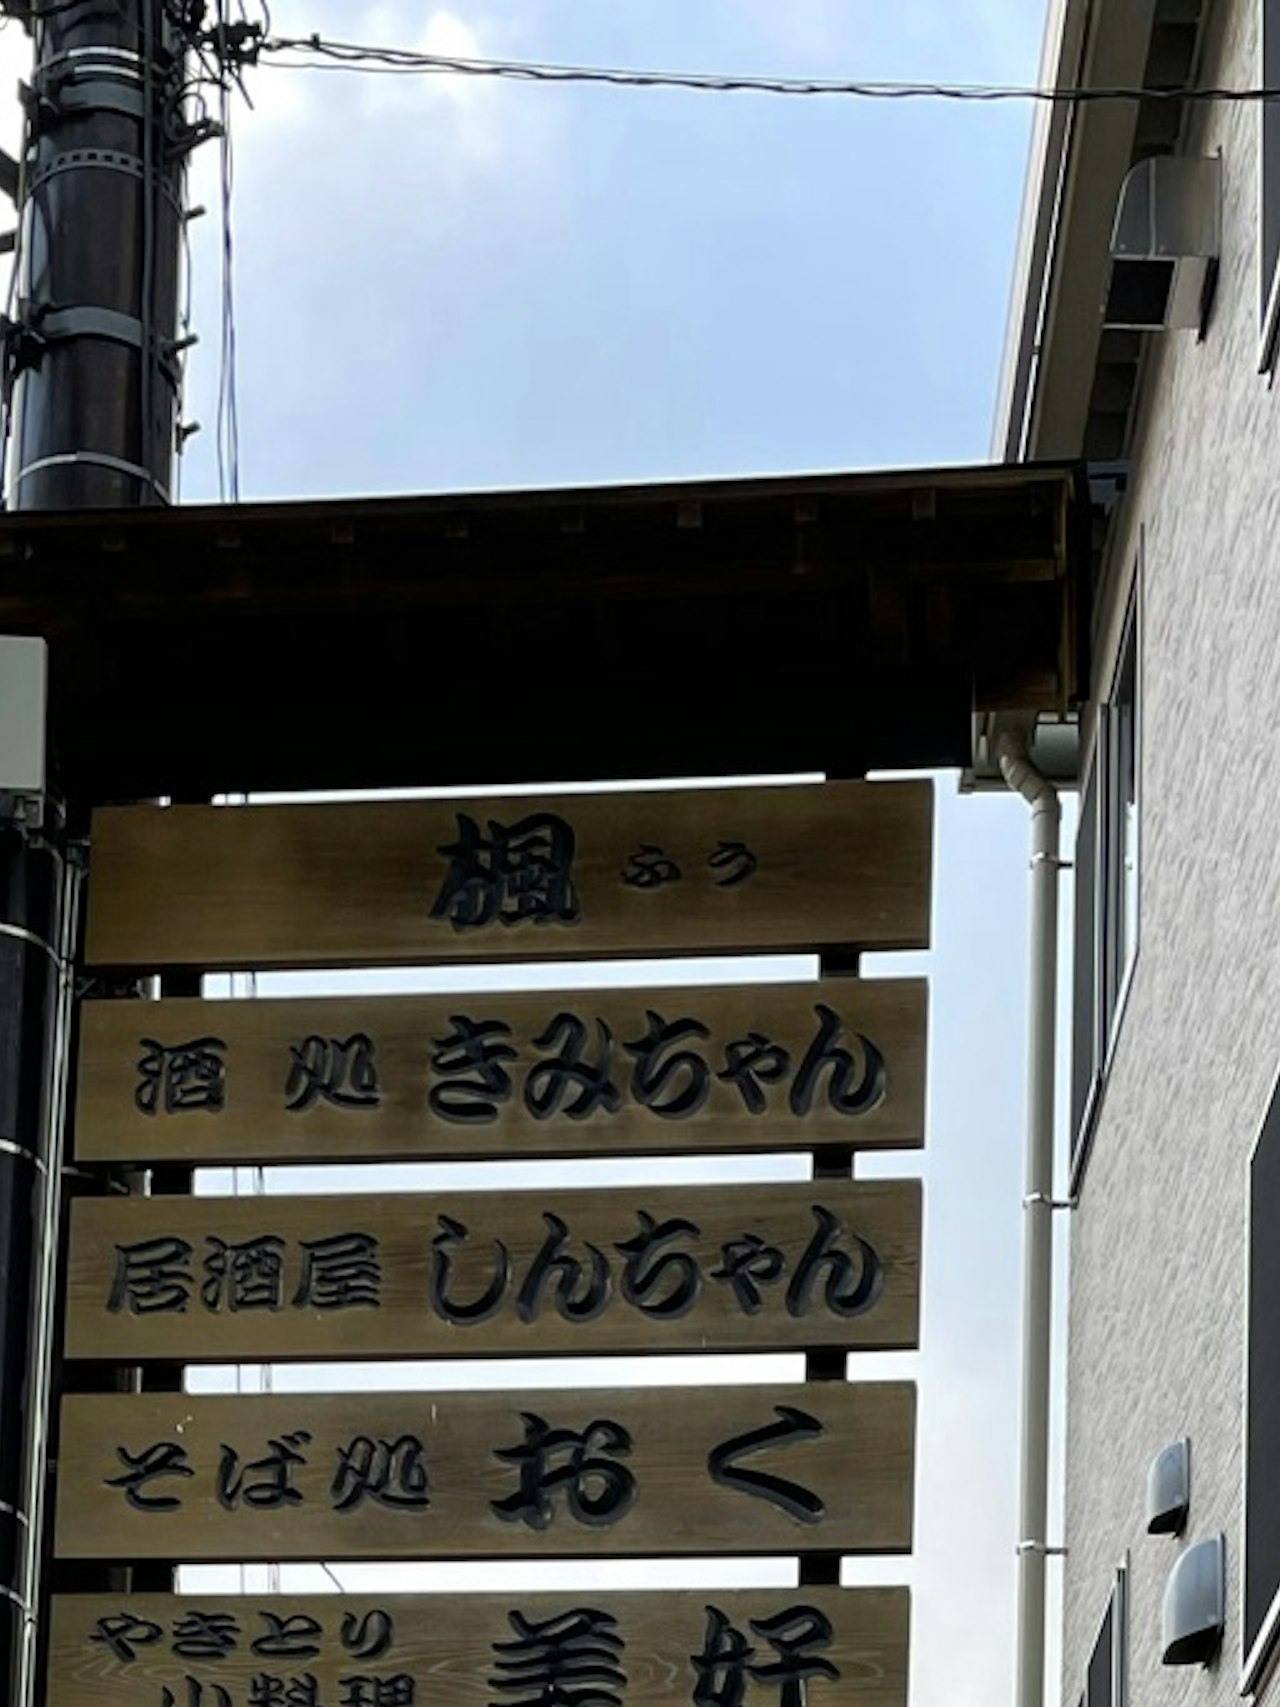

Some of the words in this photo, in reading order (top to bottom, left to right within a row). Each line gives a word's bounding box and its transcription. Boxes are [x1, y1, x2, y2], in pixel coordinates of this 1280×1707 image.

[429, 813, 580, 932] 楓
[134, 1033, 380, 1115] 酒処
[428, 1005, 885, 1123] きみちゃん
[107, 1235, 381, 1315] 居酒屋
[428, 1205, 882, 1324] しんちゃん
[105, 1432, 429, 1512] そば処
[490, 1406, 825, 1528] おく
[91, 1610, 393, 1661] やきとり
